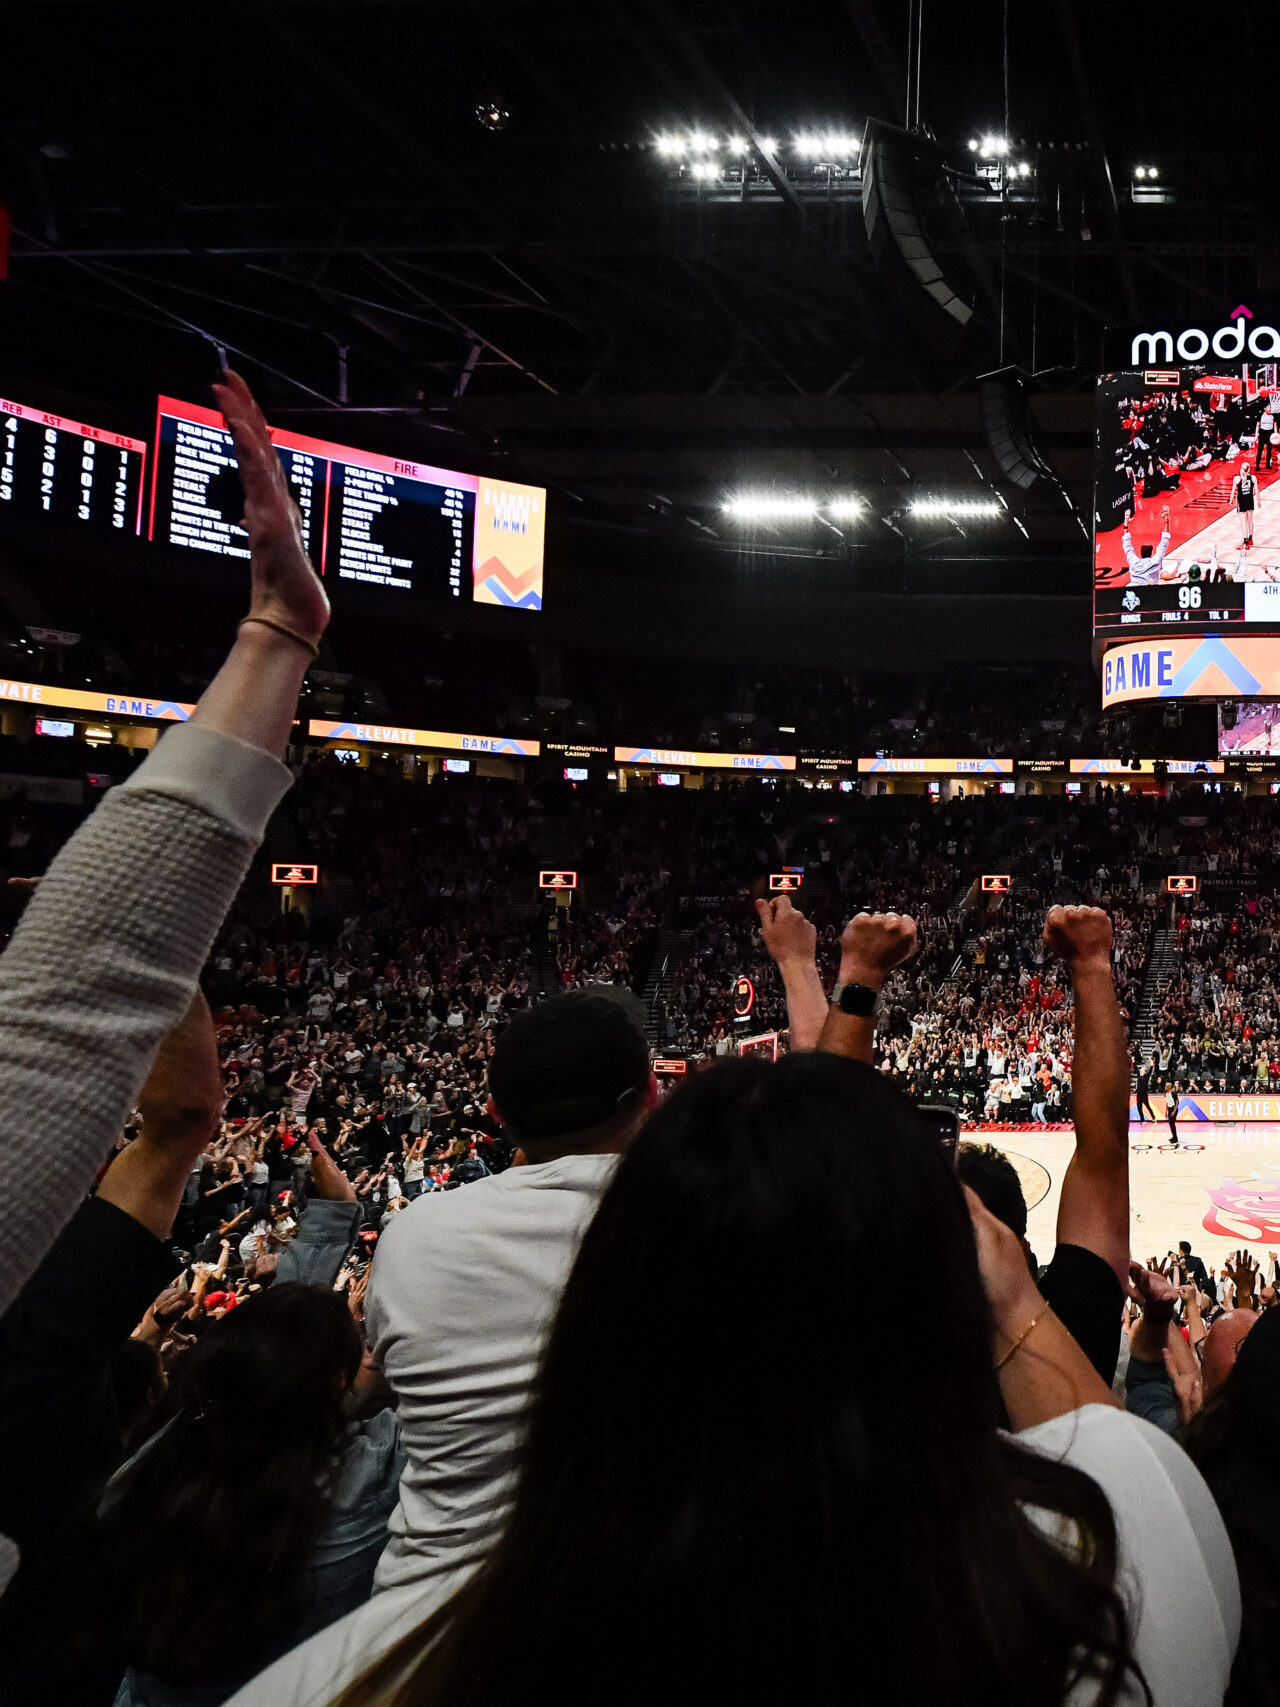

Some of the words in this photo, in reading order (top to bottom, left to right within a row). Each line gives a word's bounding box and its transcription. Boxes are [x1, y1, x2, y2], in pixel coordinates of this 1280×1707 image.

[2, 401, 23, 416] REB
[42, 414, 62, 427] AST
[80, 425, 100, 439] BLK
[115, 436, 133, 449] FLS
[5, 417, 18, 432] 4
[45, 428, 57, 444] 6
[83, 440, 96, 455] 0
[119, 450, 128, 465] 1
[6, 434, 15, 449] 1
[44, 445, 56, 461] 3
[82, 456, 94, 471] 0
[118, 466, 127, 481] 1
[5, 451, 14, 466] 1
[42, 461, 54, 477] 0
[81, 472, 93, 487] 0
[115, 481, 127, 497] 2
[394, 461, 419, 477] FIRE
[1, 467, 14, 483] 5
[41, 478, 53, 494] 2
[81, 489, 91, 504] 1
[113, 497, 125, 512] 3
[0, 484, 12, 501] 3
[41, 496, 51, 511] 1
[78, 505, 90, 520] 3
[112, 513, 124, 529] 3
[1178, 587, 1202, 609] 96
[1262, 586, 1278, 596] 4TH
[1161, 611, 1182, 622] FOULS
[1184, 611, 1190, 621] 4
[1104, 650, 1173, 697] GAME
[0, 682, 42, 702] VATE
[106, 698, 153, 716] GAME
[355, 725, 417, 744] ELEVATE
[462, 737, 497, 751] GAME
[546, 743, 568, 752] SPIRIT
[569, 744, 608, 753] MOUNTAIN
[564, 750, 590, 758] CASINO
[651, 750, 697, 765] ELEVATE
[733, 756, 761, 768] GAME
[886, 760, 925, 771] ELEVATE
[956, 761, 982, 772] GAME
[1168, 762, 1193, 773] GAME
[1209, 1100, 1270, 1117] ELEVATE
